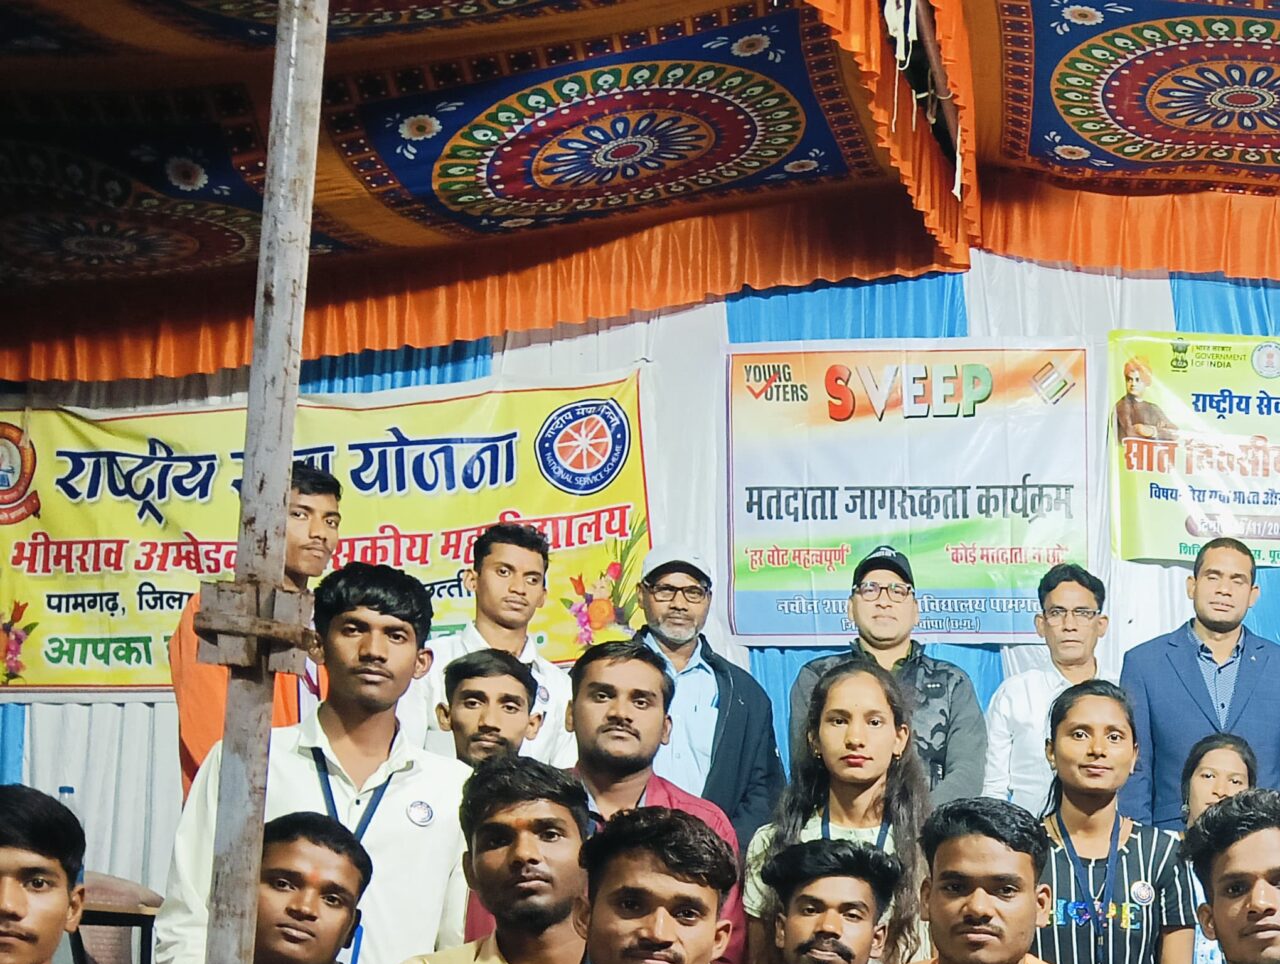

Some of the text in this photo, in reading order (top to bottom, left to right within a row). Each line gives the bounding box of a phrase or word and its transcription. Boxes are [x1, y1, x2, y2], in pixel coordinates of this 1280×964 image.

[1195, 352, 1247, 361] GOVERNMENT
[1208, 361, 1232, 369] INDIA
[744, 364, 792, 383] YOUNG
[825, 364, 993, 422] SVEEP
[1192, 388, 1252, 421] राष्ट्रीय
[1123, 436, 1178, 474] सात
[55, 437, 217, 523] राष्ट्रीय
[348, 427, 518, 493] योजना
[745, 486, 839, 522] मतदाता
[976, 473, 1075, 524] कार्यक्रम
[11, 531, 130, 574] भीमराव
[767, 544, 789, 566] वोट
[46, 591, 126, 617] पामगढ़,
[777, 594, 818, 614] नवीन
[44, 636, 152, 666] आपका
